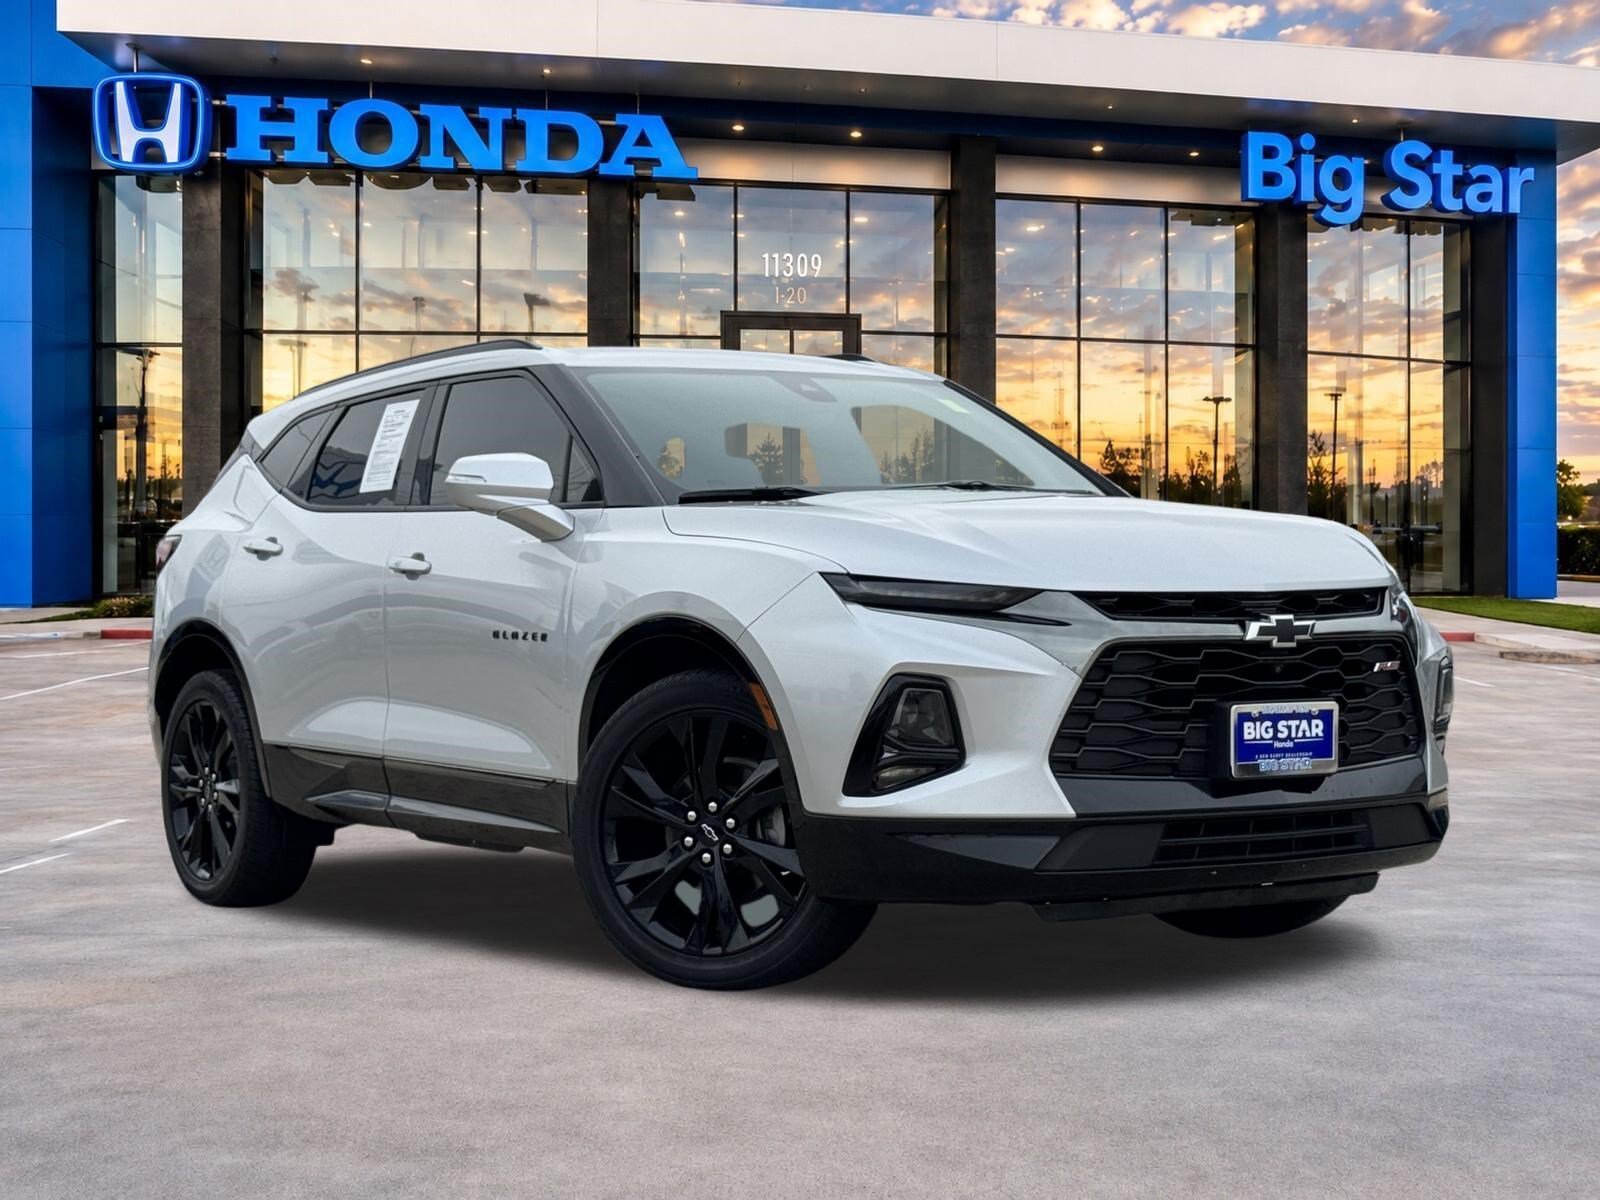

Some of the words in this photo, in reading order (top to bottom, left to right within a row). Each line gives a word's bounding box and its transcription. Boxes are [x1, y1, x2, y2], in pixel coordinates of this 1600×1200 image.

[225, 94, 698, 179] HONDA
[1243, 131, 1366, 226] Big
[1384, 139, 1535, 213] Star
[761, 252, 822, 278] 11309
[492, 630, 548, 642] BLAZER
[1243, 721, 1274, 740] BIG
[1277, 719, 1324, 738] STAR
[1273, 740, 1294, 748] Honda
[1258, 759, 1279, 771] BIG
[1280, 757, 1312, 770] STAR
